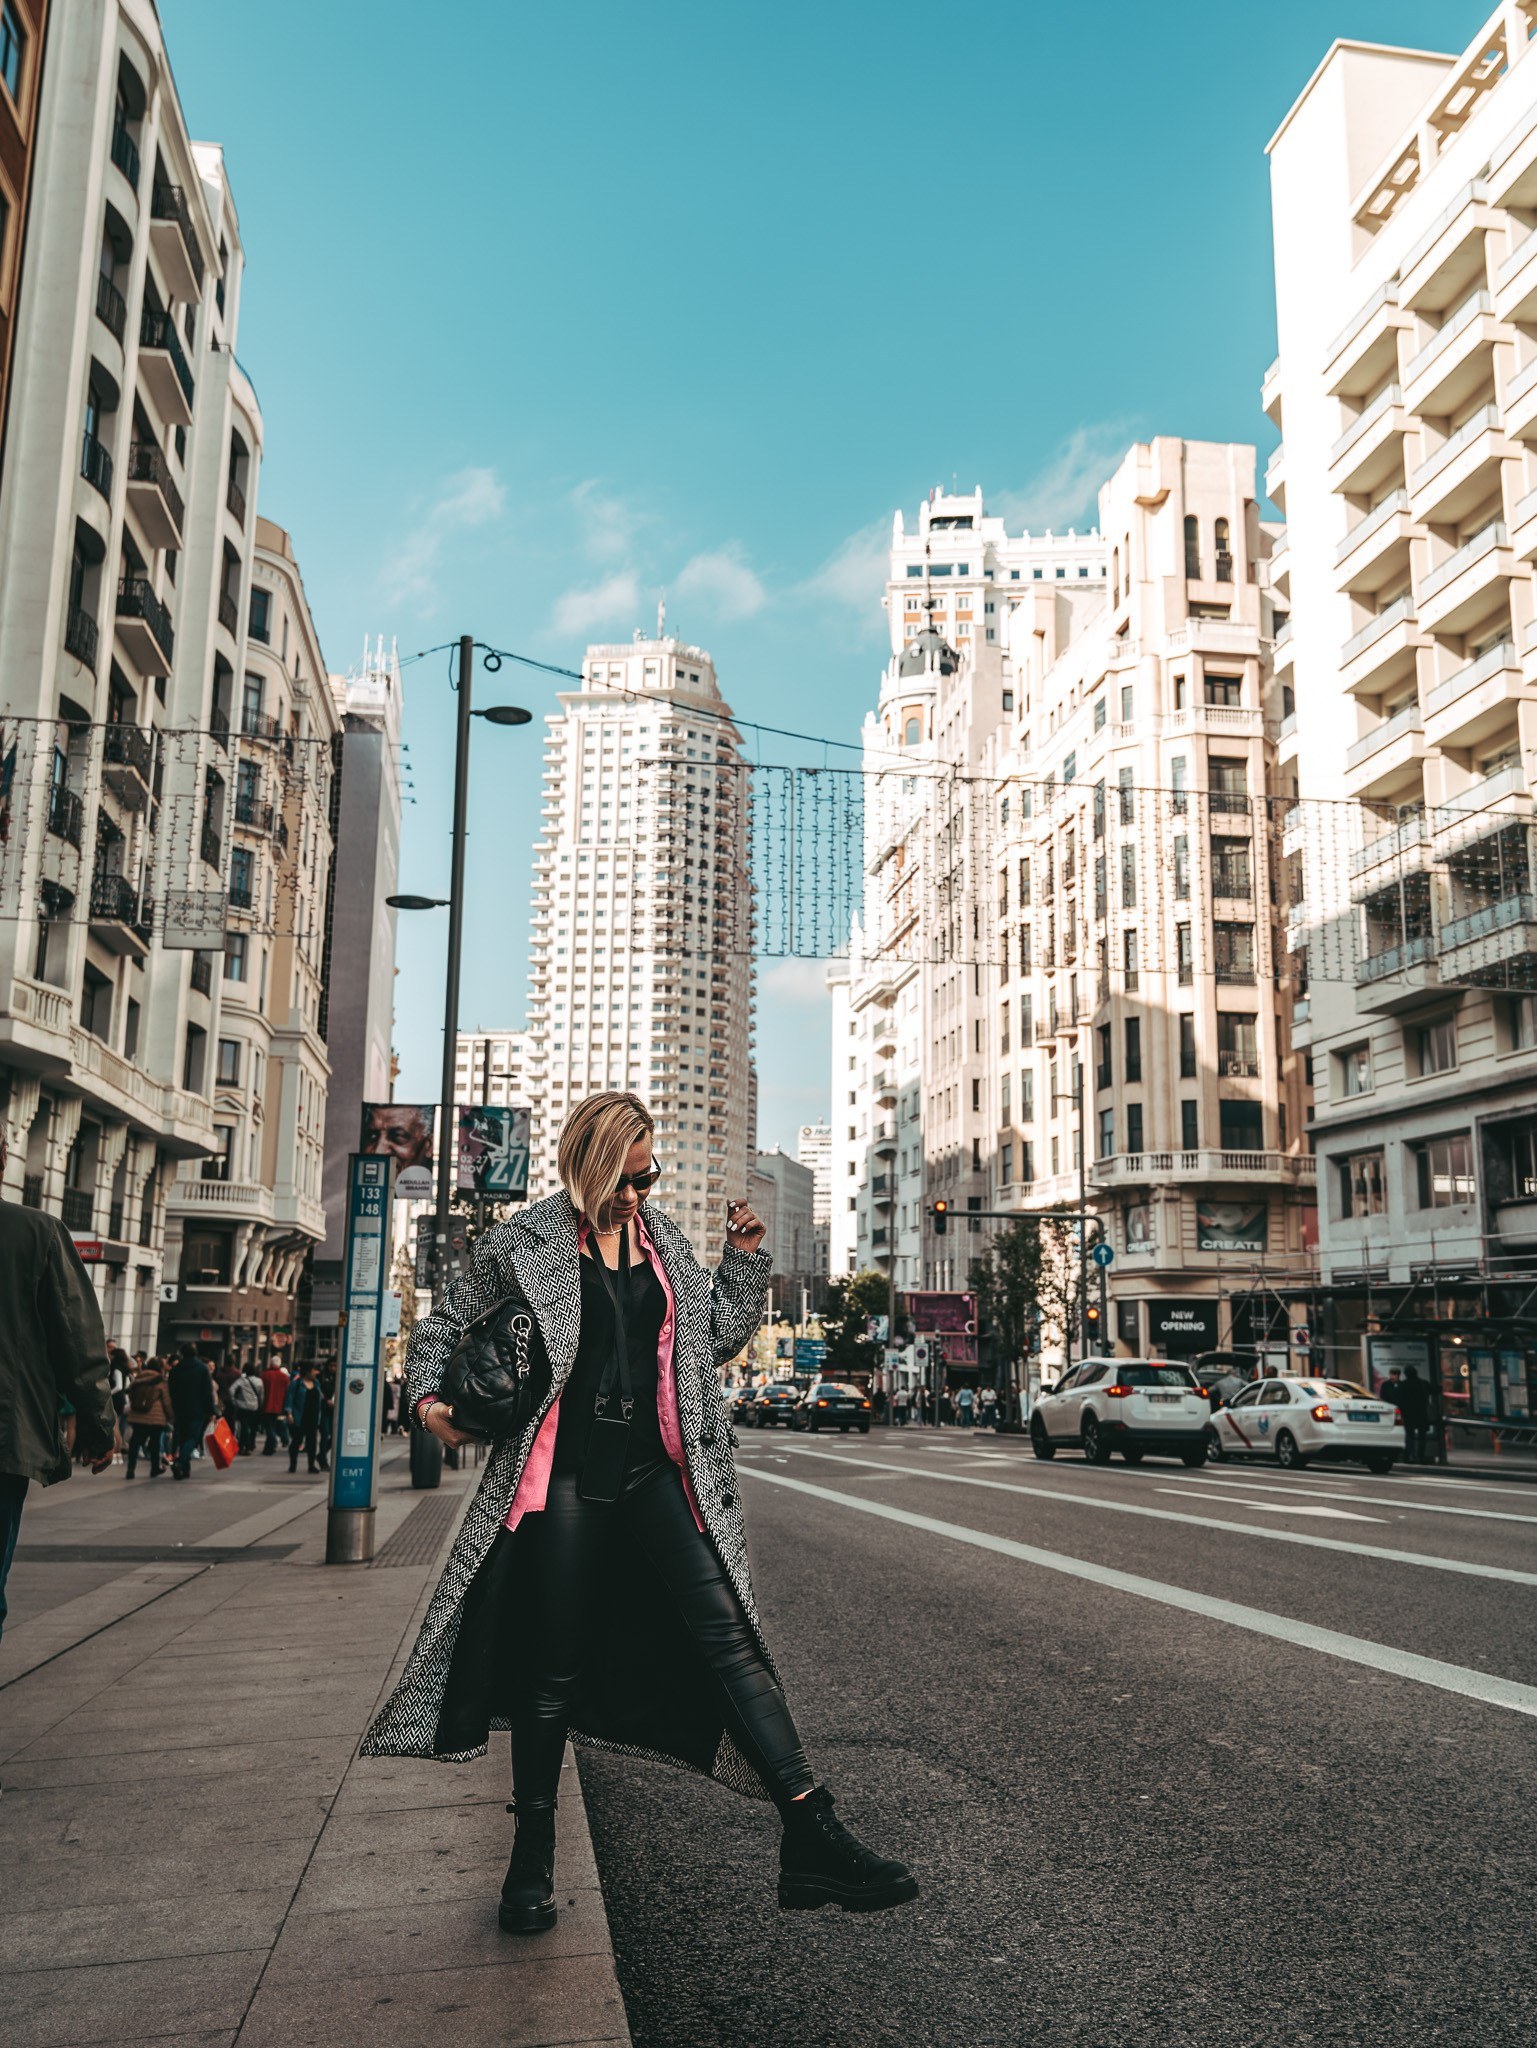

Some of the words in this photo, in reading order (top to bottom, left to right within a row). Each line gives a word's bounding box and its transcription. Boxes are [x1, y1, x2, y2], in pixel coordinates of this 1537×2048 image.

[460, 1165, 484, 1175] NOV
[361, 1187, 380, 1199] 133
[360, 1203, 379, 1215] 148
[1201, 1239, 1263, 1250] CREATE
[1171, 1310, 1195, 1320] NEW
[1160, 1321, 1206, 1331] OPENING
[342, 1468, 364, 1477] EMT
